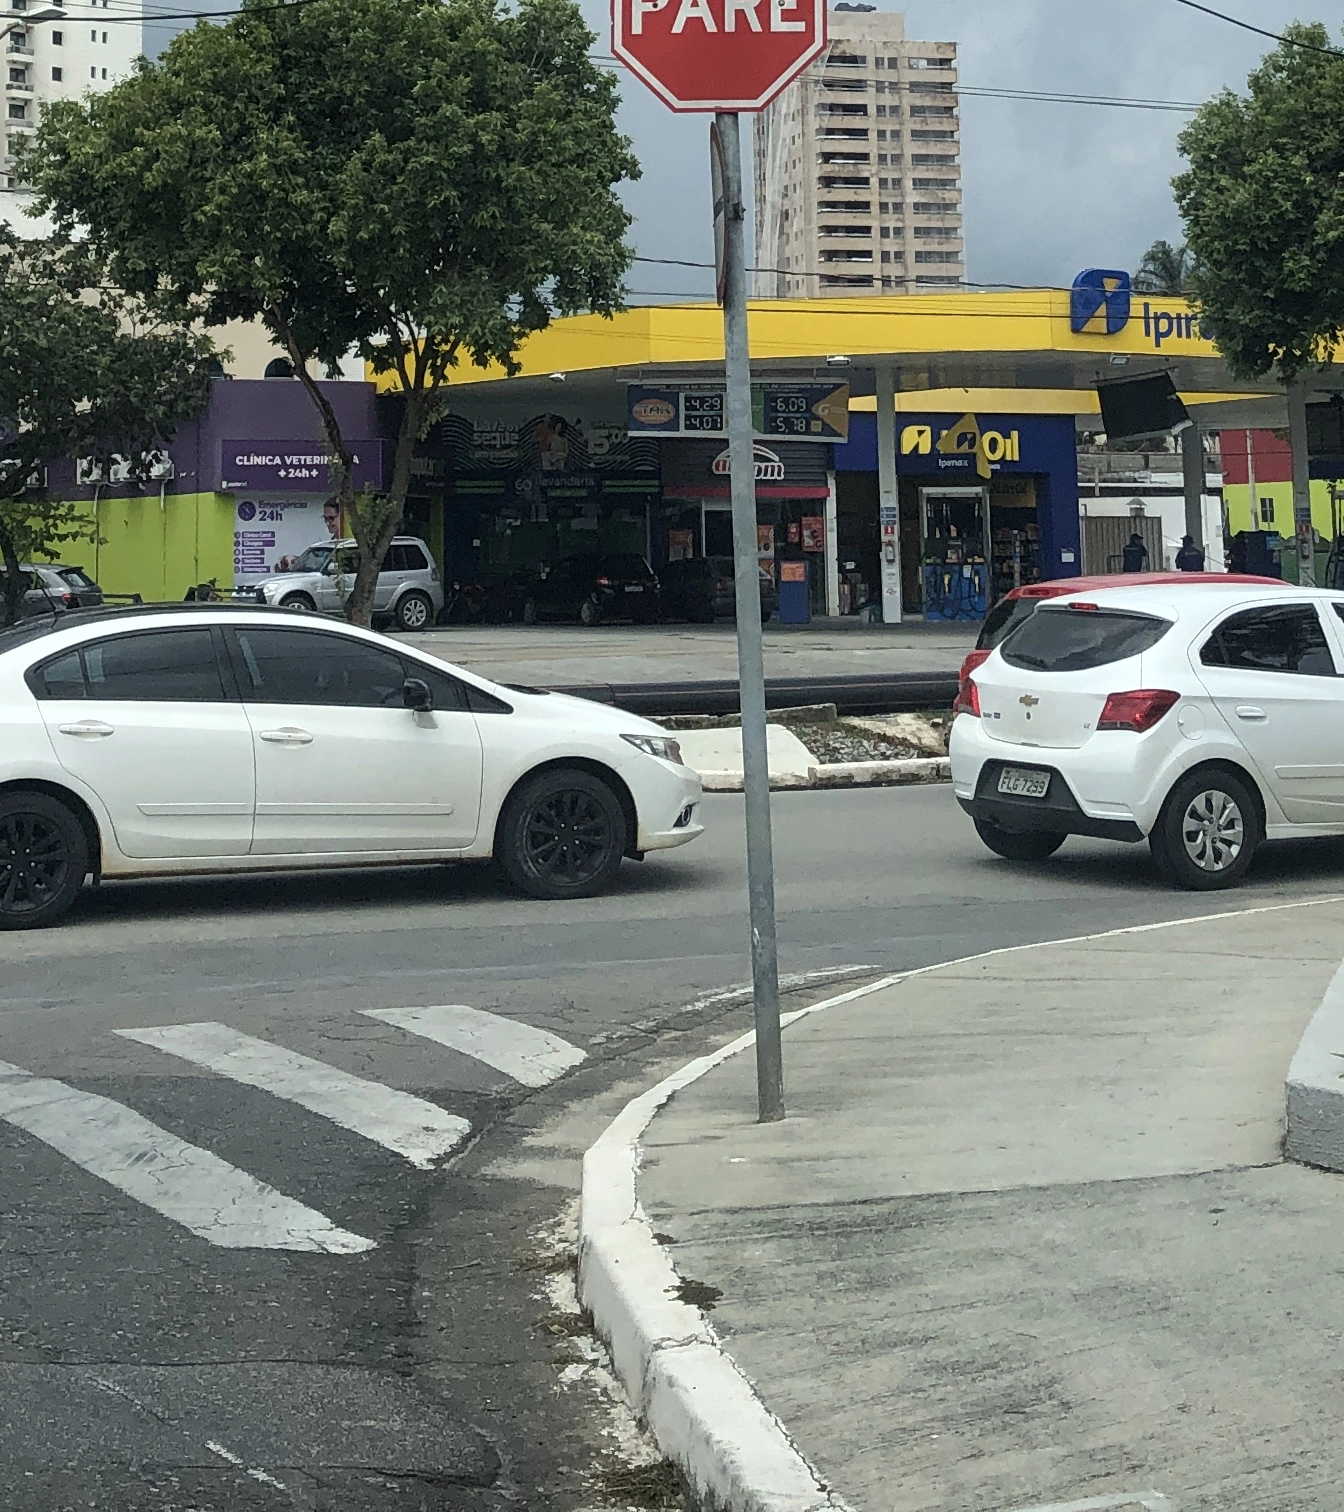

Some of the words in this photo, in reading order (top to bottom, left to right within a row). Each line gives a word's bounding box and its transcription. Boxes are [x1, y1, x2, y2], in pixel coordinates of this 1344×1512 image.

[236, 453, 281, 465] CLÍNICA
[284, 453, 360, 465] VETERINÁA
[288, 468, 310, 478] 24h
[259, 510, 283, 521] 24h
